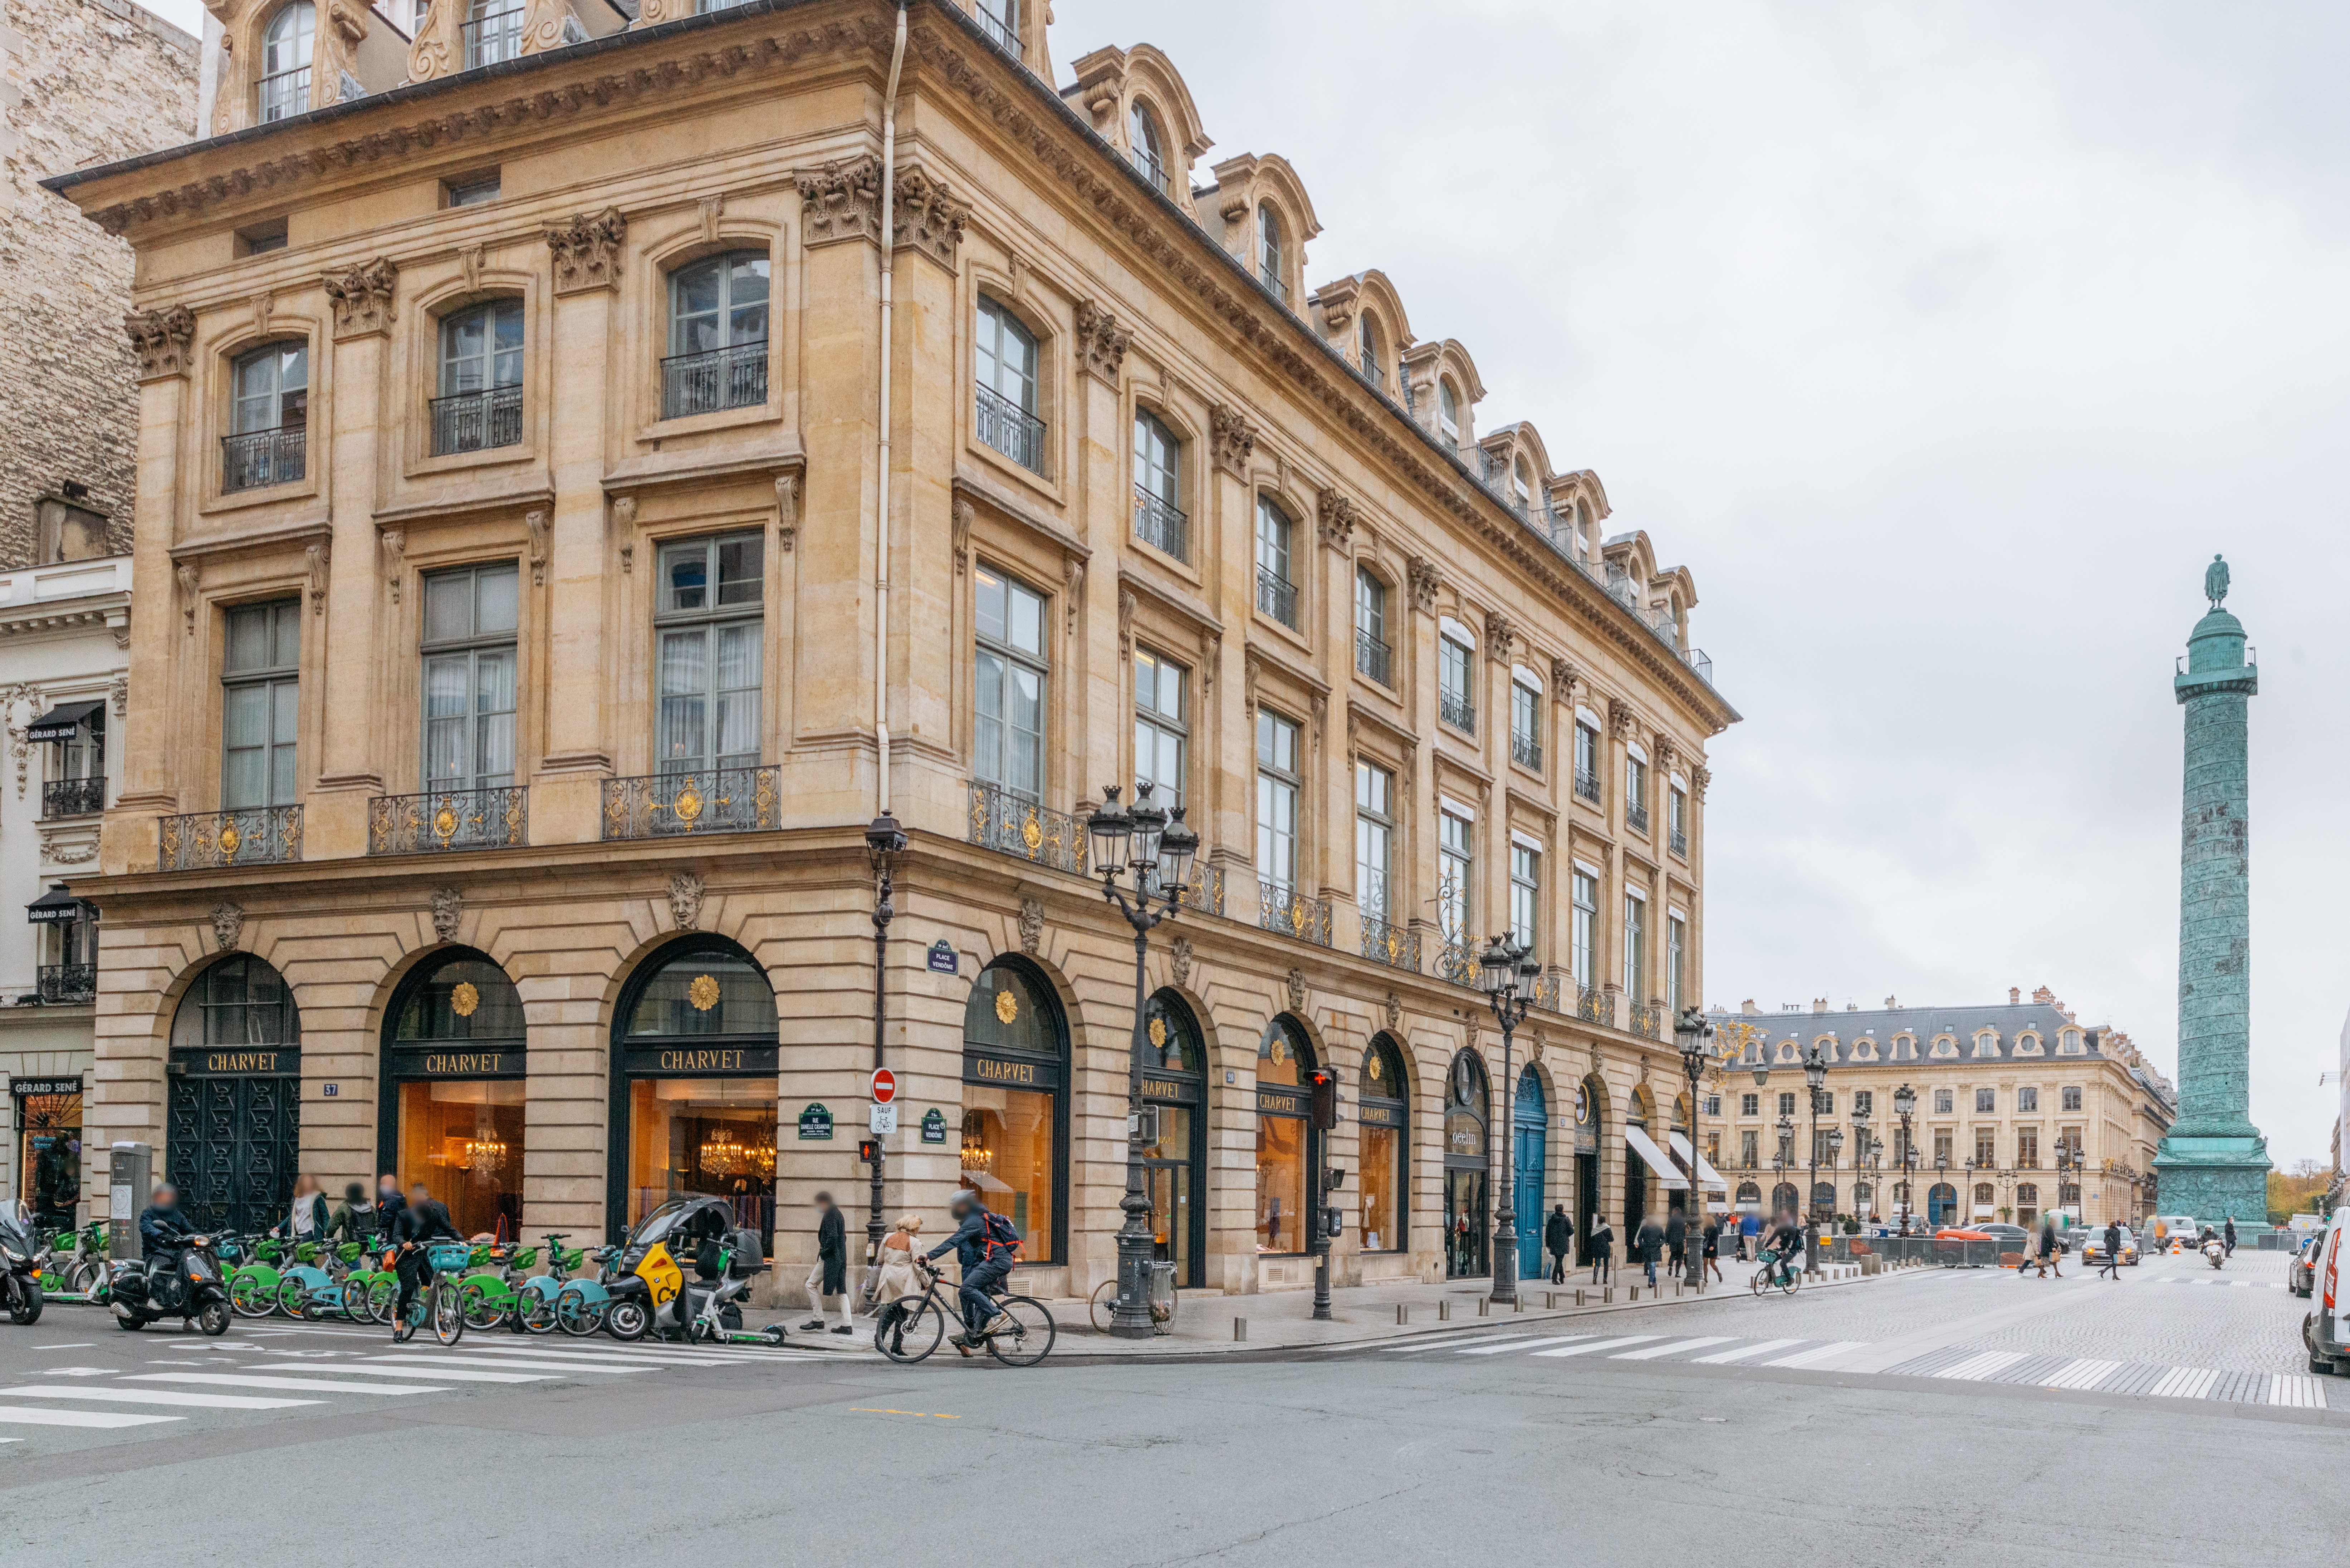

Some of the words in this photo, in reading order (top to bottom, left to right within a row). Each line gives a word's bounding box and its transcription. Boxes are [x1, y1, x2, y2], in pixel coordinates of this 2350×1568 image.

[29, 729, 56, 739] GÉRARD
[59, 726, 75, 736] SENÉ
[30, 910, 57, 919] GÉRARD
[59, 908, 75, 917] SENÉ
[932, 961, 953, 970] VENDÔME
[208, 1053, 278, 1071] CHARVET
[427, 1053, 501, 1072] CHARVET
[661, 1050, 744, 1070] CHARVET
[977, 1059, 1035, 1083] CHARVET
[1228, 1073, 1234, 1081] 28
[15, 1081, 52, 1093] GÉRARD
[55, 1080, 77, 1092] SENÉ
[325, 1085, 336, 1095] 37
[1141, 1079, 1179, 1098] HARVET
[1259, 1094, 1296, 1111] CHARVET
[1361, 1106, 1390, 1122] CHARVET
[1872, 1229, 1880, 1238] P
